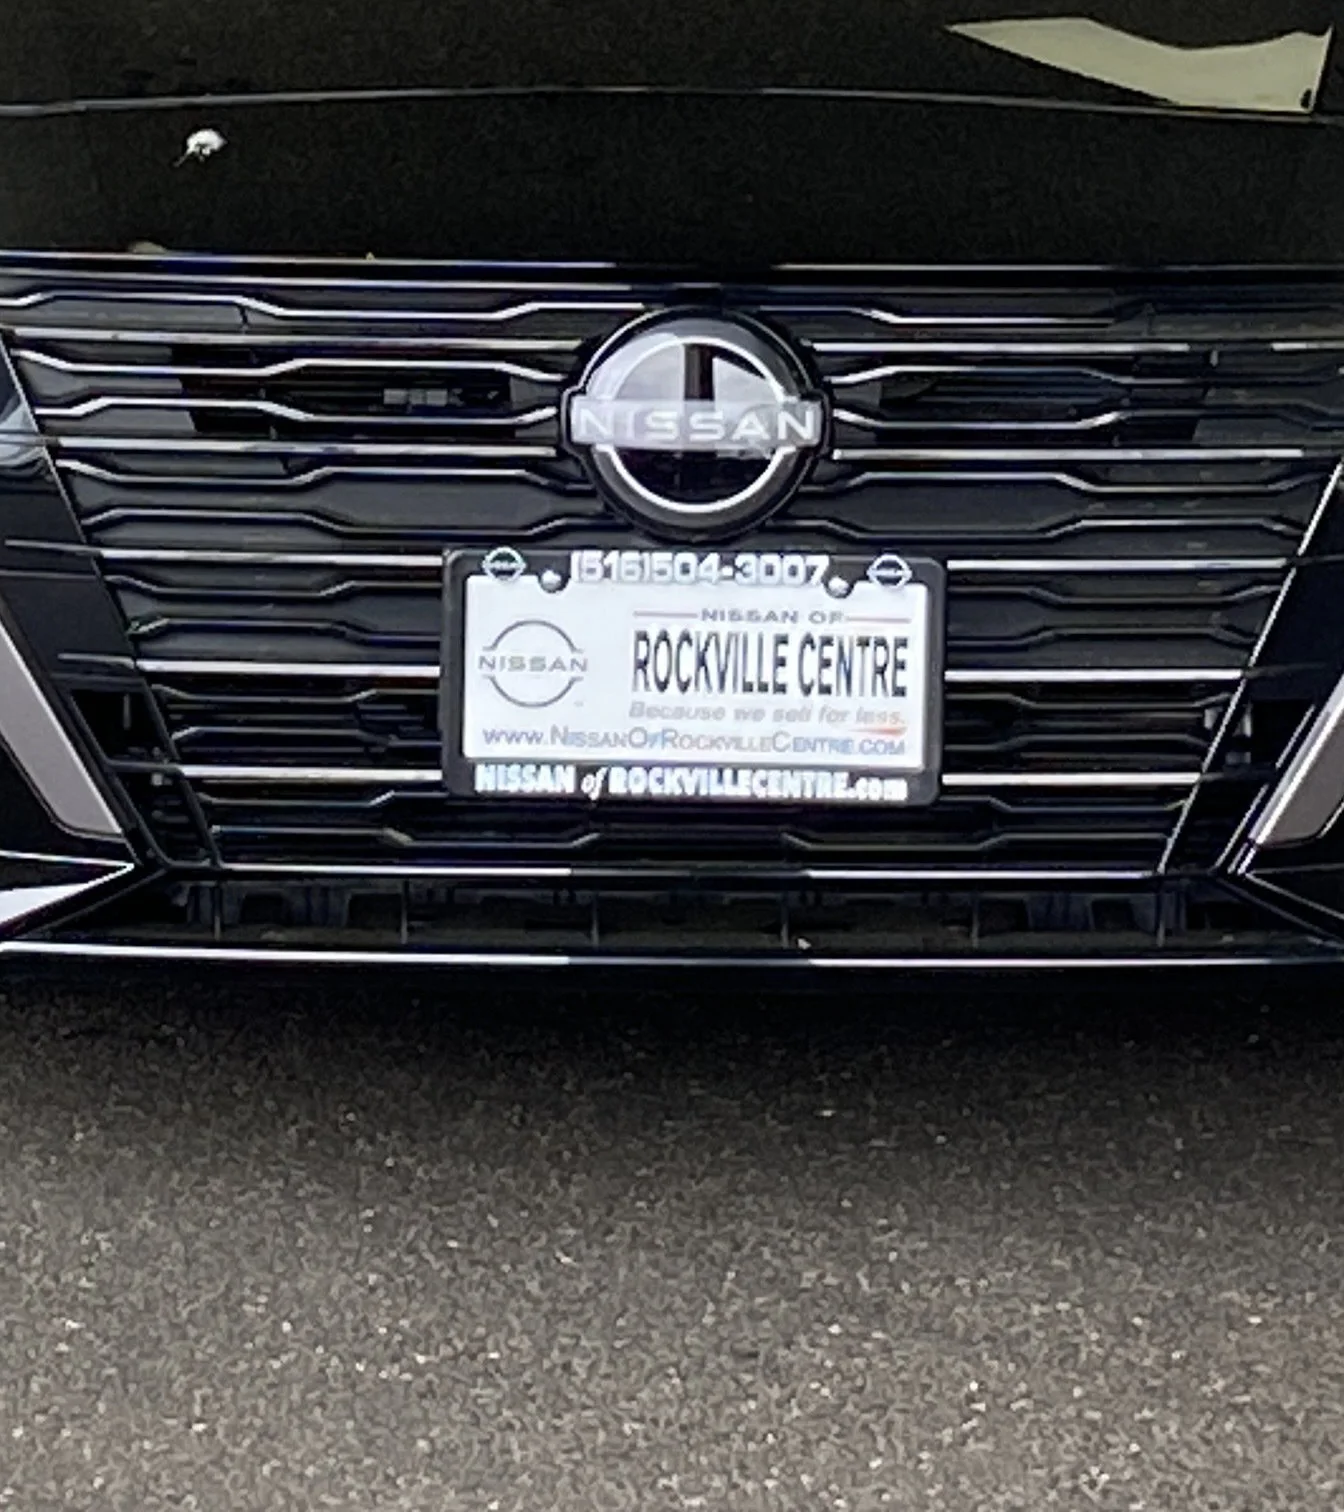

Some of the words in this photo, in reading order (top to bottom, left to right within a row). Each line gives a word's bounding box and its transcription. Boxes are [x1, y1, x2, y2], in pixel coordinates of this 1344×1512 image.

[578, 406, 816, 442] NISSAN
[701, 609, 799, 625] NISSAN
[808, 610, 843, 625] OF
[478, 654, 589, 673] NISSAN
[632, 628, 789, 695] ROCKVILLE
[798, 632, 908, 698] CENTRE
[629, 700, 726, 720] Because
[734, 706, 765, 721] we
[772, 703, 811, 723] sell
[818, 703, 850, 725] for
[474, 762, 576, 794] NISSAN
[580, 765, 607, 801] of
[608, 765, 909, 801] ROCKVILLECENTRE.com
